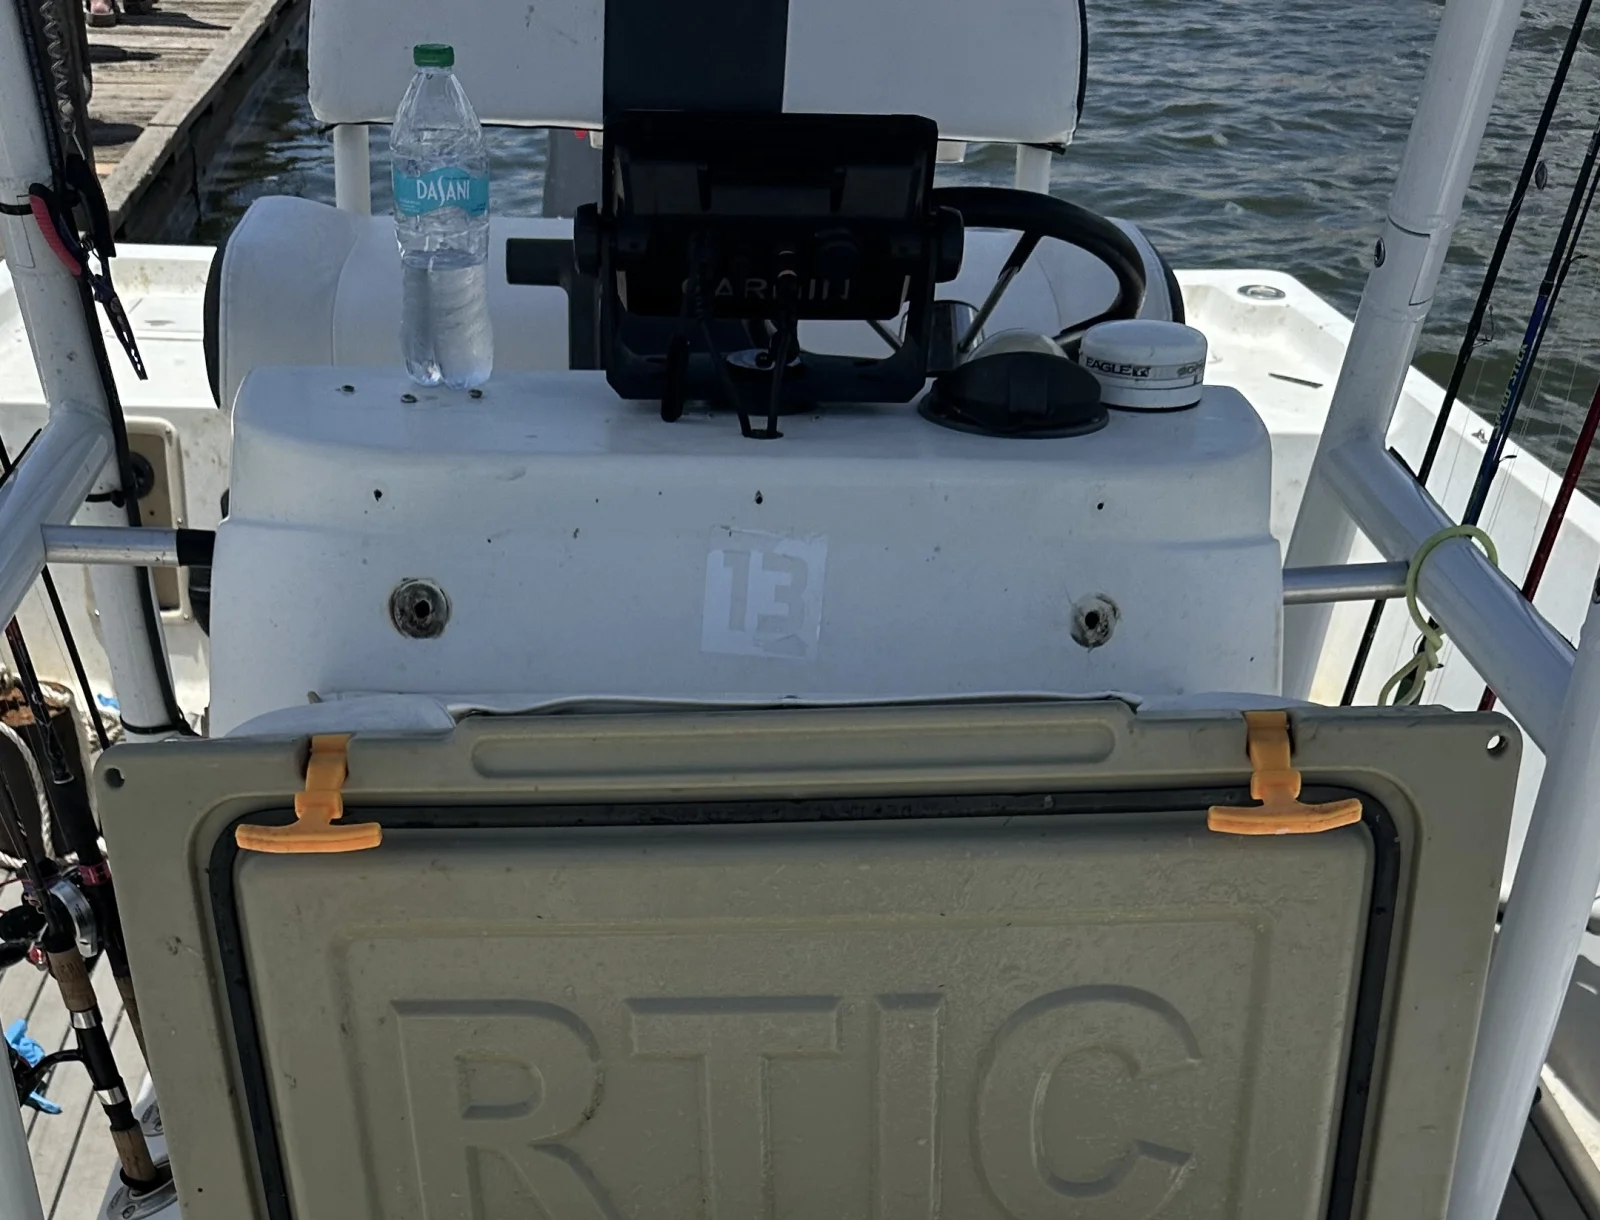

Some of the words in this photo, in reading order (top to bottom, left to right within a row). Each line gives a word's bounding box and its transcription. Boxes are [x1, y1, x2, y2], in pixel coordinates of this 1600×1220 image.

[416, 175, 470, 206] DASANI
[1086, 356, 1132, 376] EAGLE
[1507, 343, 1528, 386] STICK
[721, 549, 811, 645] 13
